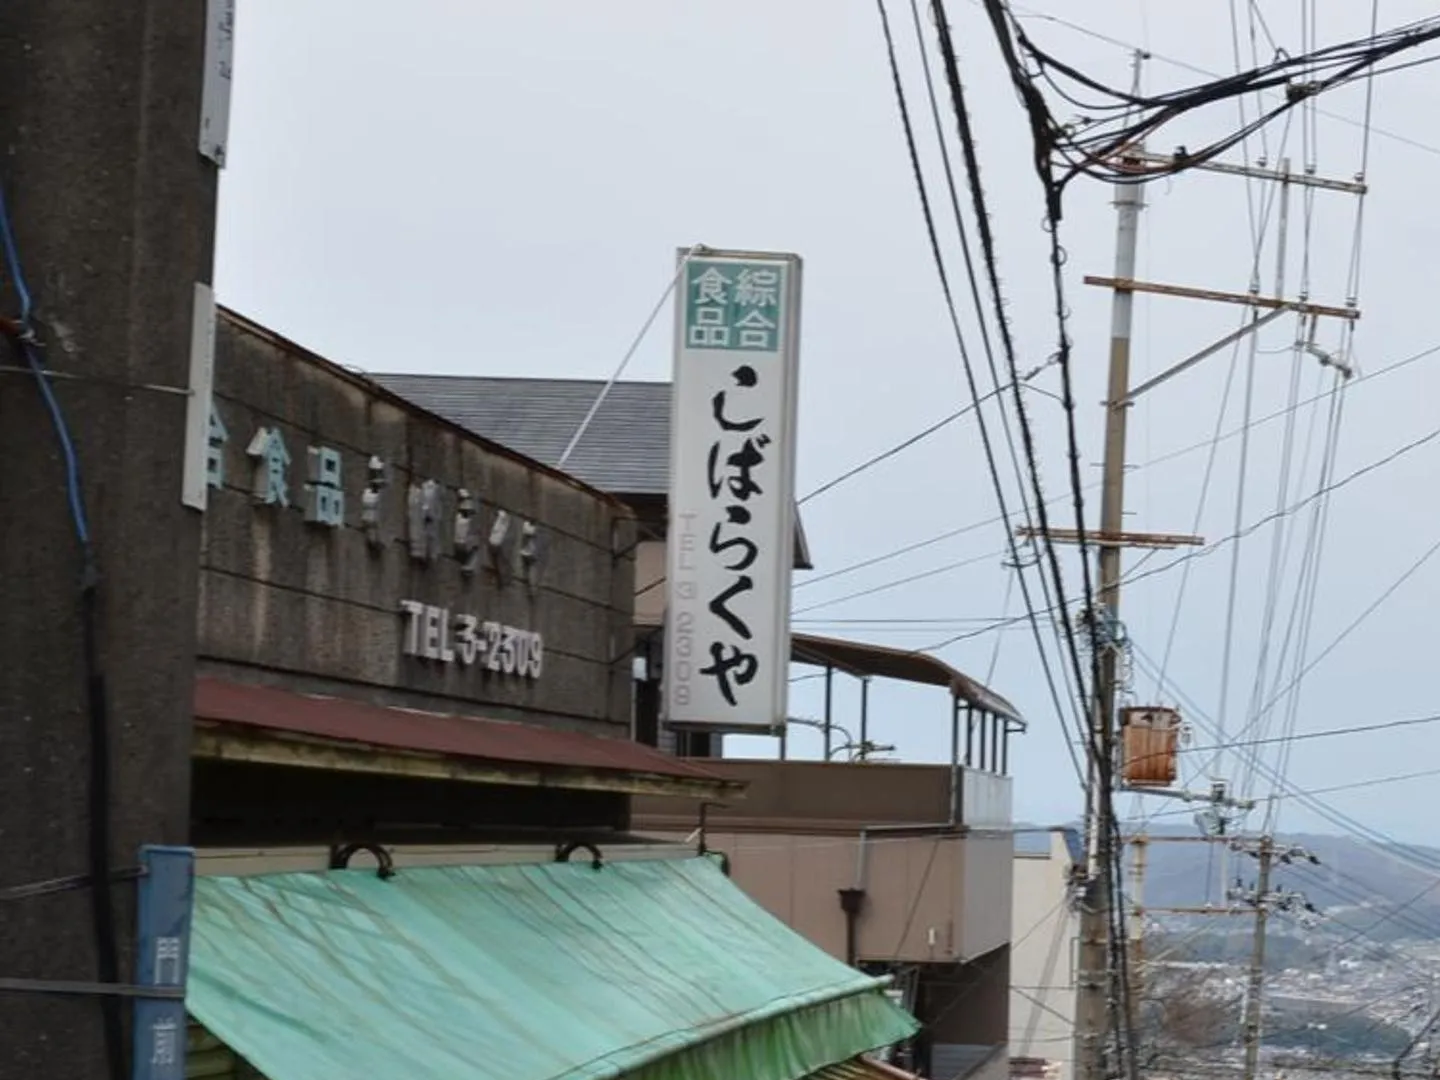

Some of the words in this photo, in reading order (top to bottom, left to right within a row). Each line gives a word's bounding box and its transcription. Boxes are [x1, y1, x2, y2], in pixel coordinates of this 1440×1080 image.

[679, 512, 698, 571] TEL
[699, 364, 772, 707] こばらくや
[400, 599, 455, 663] TEL
